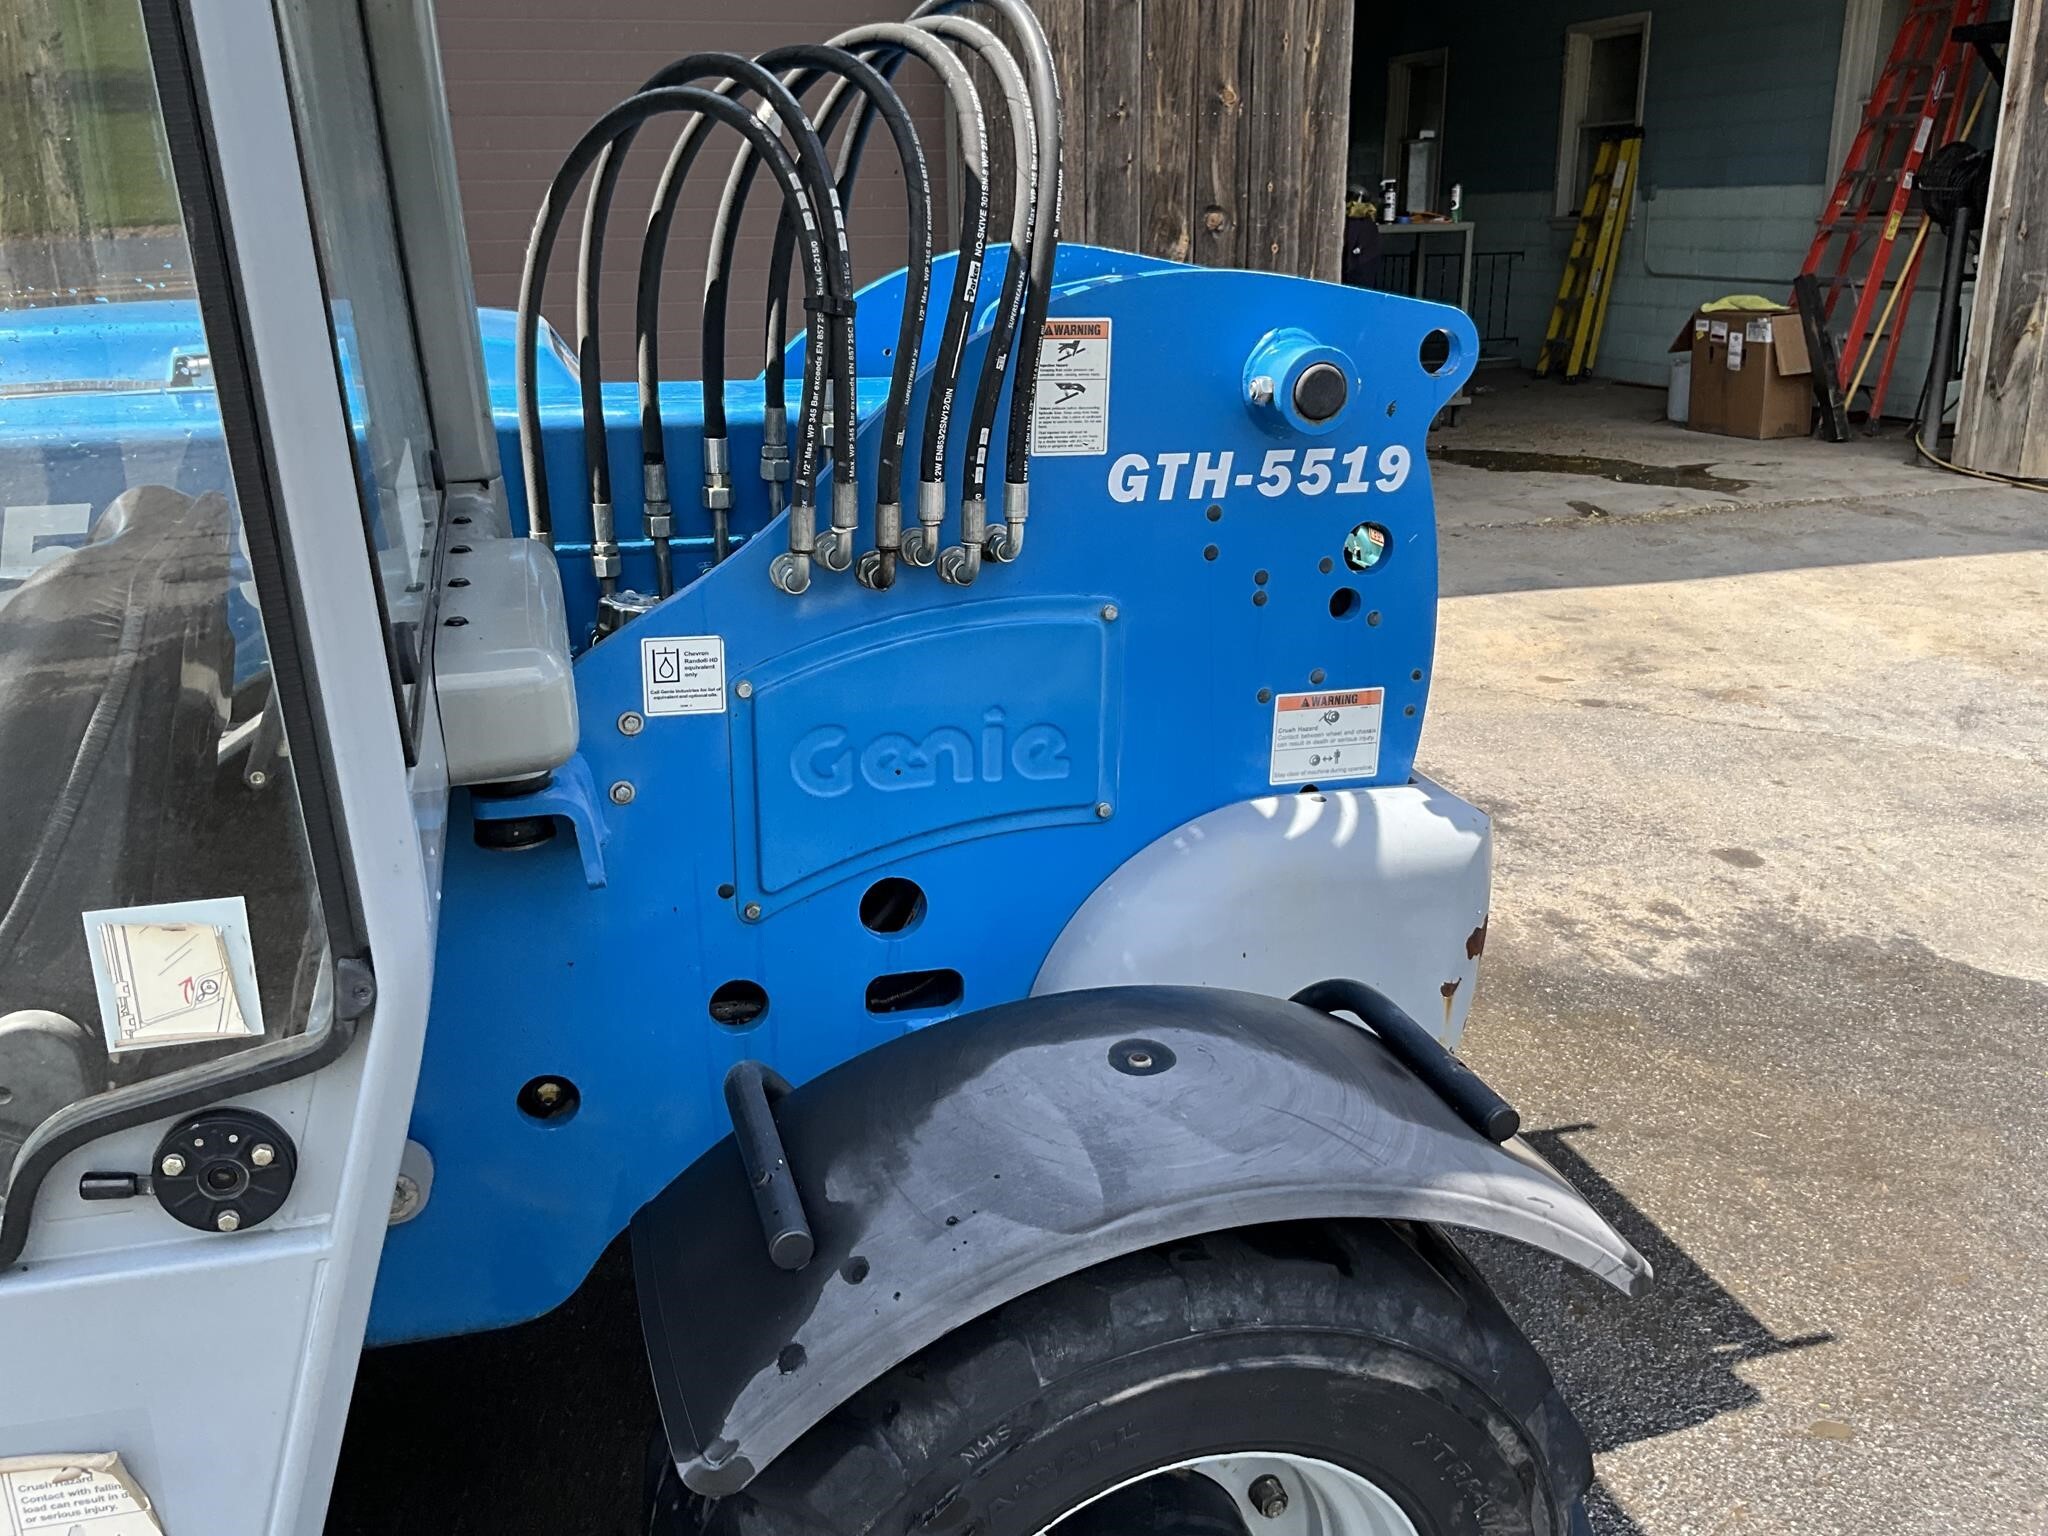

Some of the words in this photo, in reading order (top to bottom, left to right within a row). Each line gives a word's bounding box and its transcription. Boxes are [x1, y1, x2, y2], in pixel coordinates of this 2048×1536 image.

[922, 180, 930, 193] EN
[1055, 168, 1063, 222] INTERPUMP
[1030, 189, 1037, 203] WP
[1028, 206, 1036, 226] Max.
[974, 210, 988, 257] NO-SKIVE
[923, 266, 931, 281] WP
[965, 263, 981, 302] Parker
[920, 284, 929, 304] Max.
[918, 305, 926, 322] 1/2"
[1007, 281, 1024, 329] SUPERSTREAM
[816, 323, 824, 340] 857
[1053, 324, 1101, 336] WARNING
[815, 341, 824, 354] EN
[813, 356, 823, 390] exceeds
[848, 362, 855, 375] EN
[904, 358, 918, 406] SUPERSTREAM
[811, 391, 819, 406] Bar
[808, 408, 818, 423] 345
[807, 423, 816, 438] WP
[804, 440, 814, 459] Max.
[848, 443, 855, 458] WP
[802, 460, 812, 476] 1/2"
[1107, 444, 1411, 503] GTH-5519
[1311, 694, 1358, 707] WARNING
[790, 704, 1071, 798] Genie
[18, 1480, 52, 1493] Crush
[20, 1492, 65, 1504] Contact
[68, 1488, 91, 1497] with
[95, 1483, 122, 1493] fallin
[23, 1504, 47, 1514] load
[50, 1501, 70, 1510] can
[74, 1495, 104, 1506] result
[40, 1510, 82, 1521] serious
[84, 1504, 118, 1515] injury.
